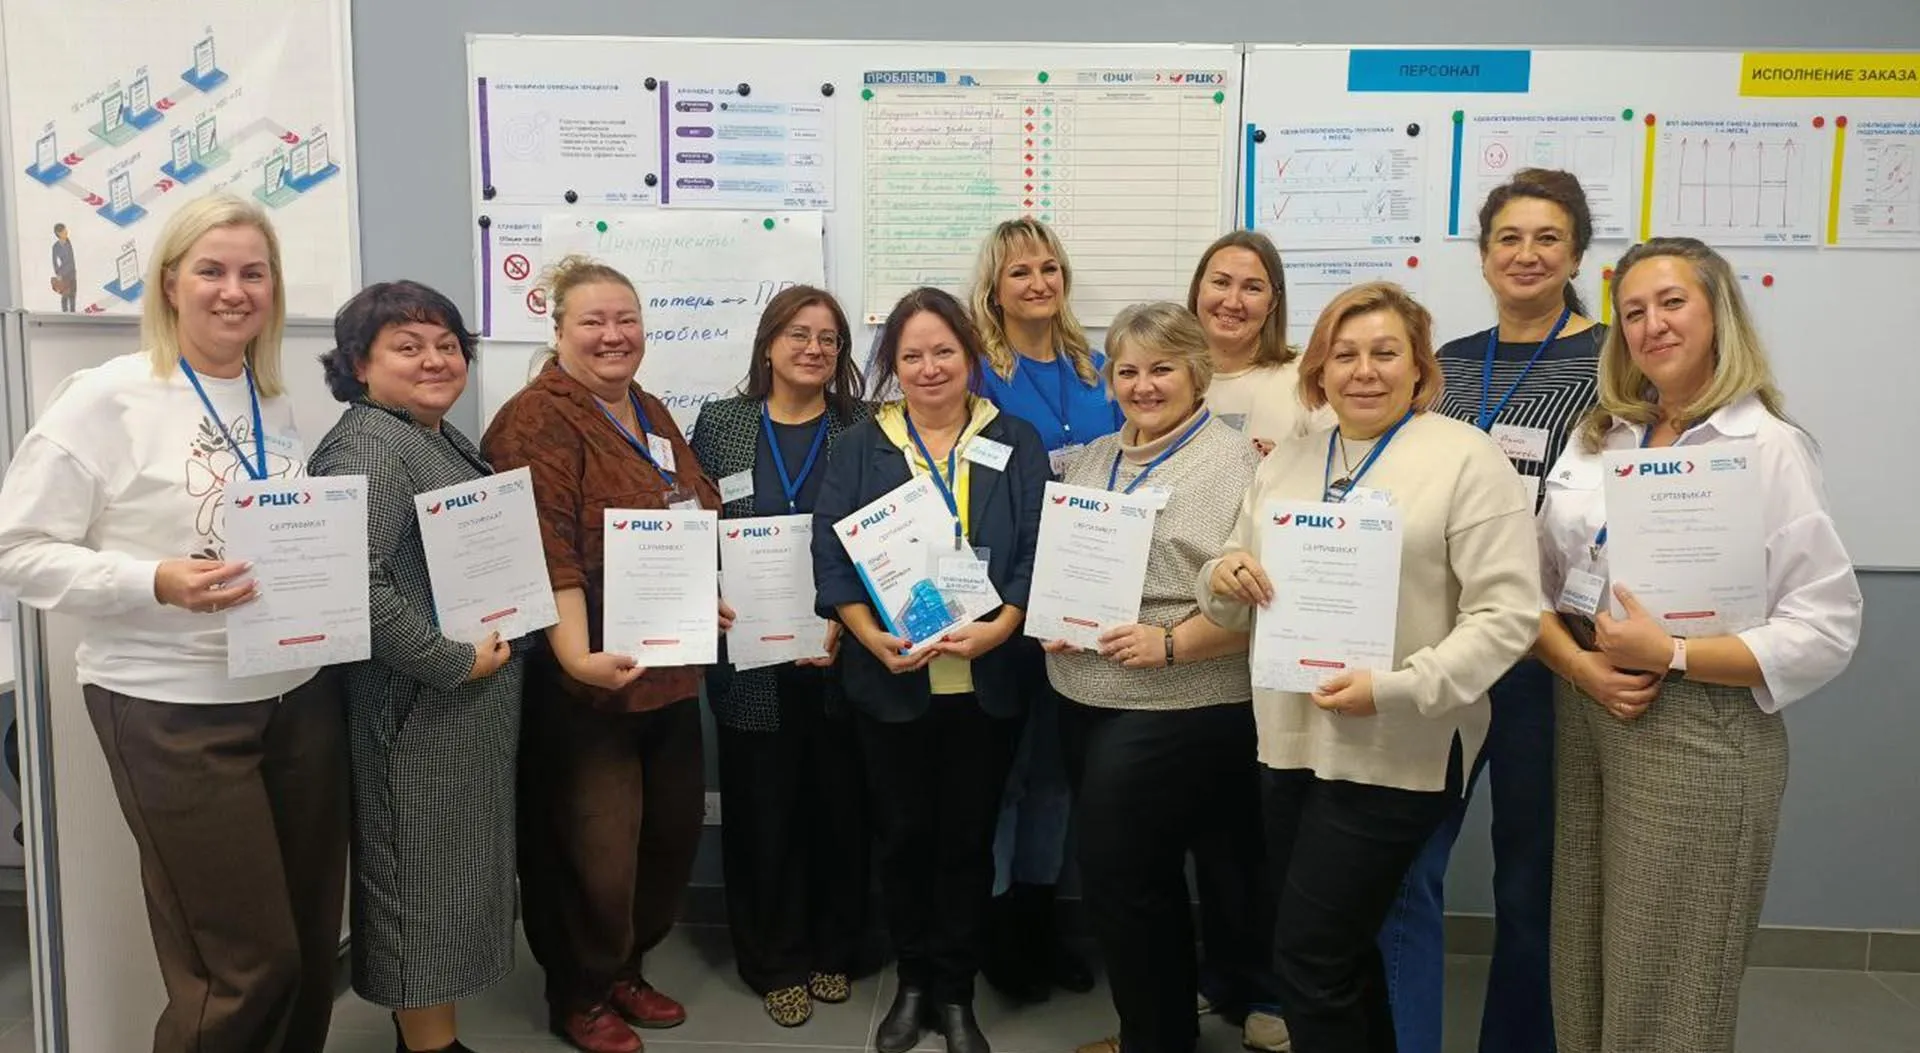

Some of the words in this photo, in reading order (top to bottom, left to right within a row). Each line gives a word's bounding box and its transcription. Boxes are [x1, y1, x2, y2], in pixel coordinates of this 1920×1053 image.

[866, 71, 937, 83] ПРОБЛЕМЫ
[1399, 64, 1480, 78] ПЕРСОНАЛ
[1751, 68, 1854, 82] ИСПОЛНЕНИЕ
[1858, 69, 1918, 82] ЗАКАЗА
[1102, 72, 1133, 85] ФЦК
[1185, 73, 1215, 84] РЦК
[649, 295, 715, 310] потерь
[1638, 461, 1682, 476] РЦК
[259, 491, 301, 507] РЦК
[444, 492, 480, 511] РЦК
[1068, 496, 1103, 512] РЦК
[860, 507, 890, 530] РЦК
[1295, 514, 1335, 529] РЦК
[631, 520, 665, 532] РЦК
[743, 526, 773, 538] РЦК
